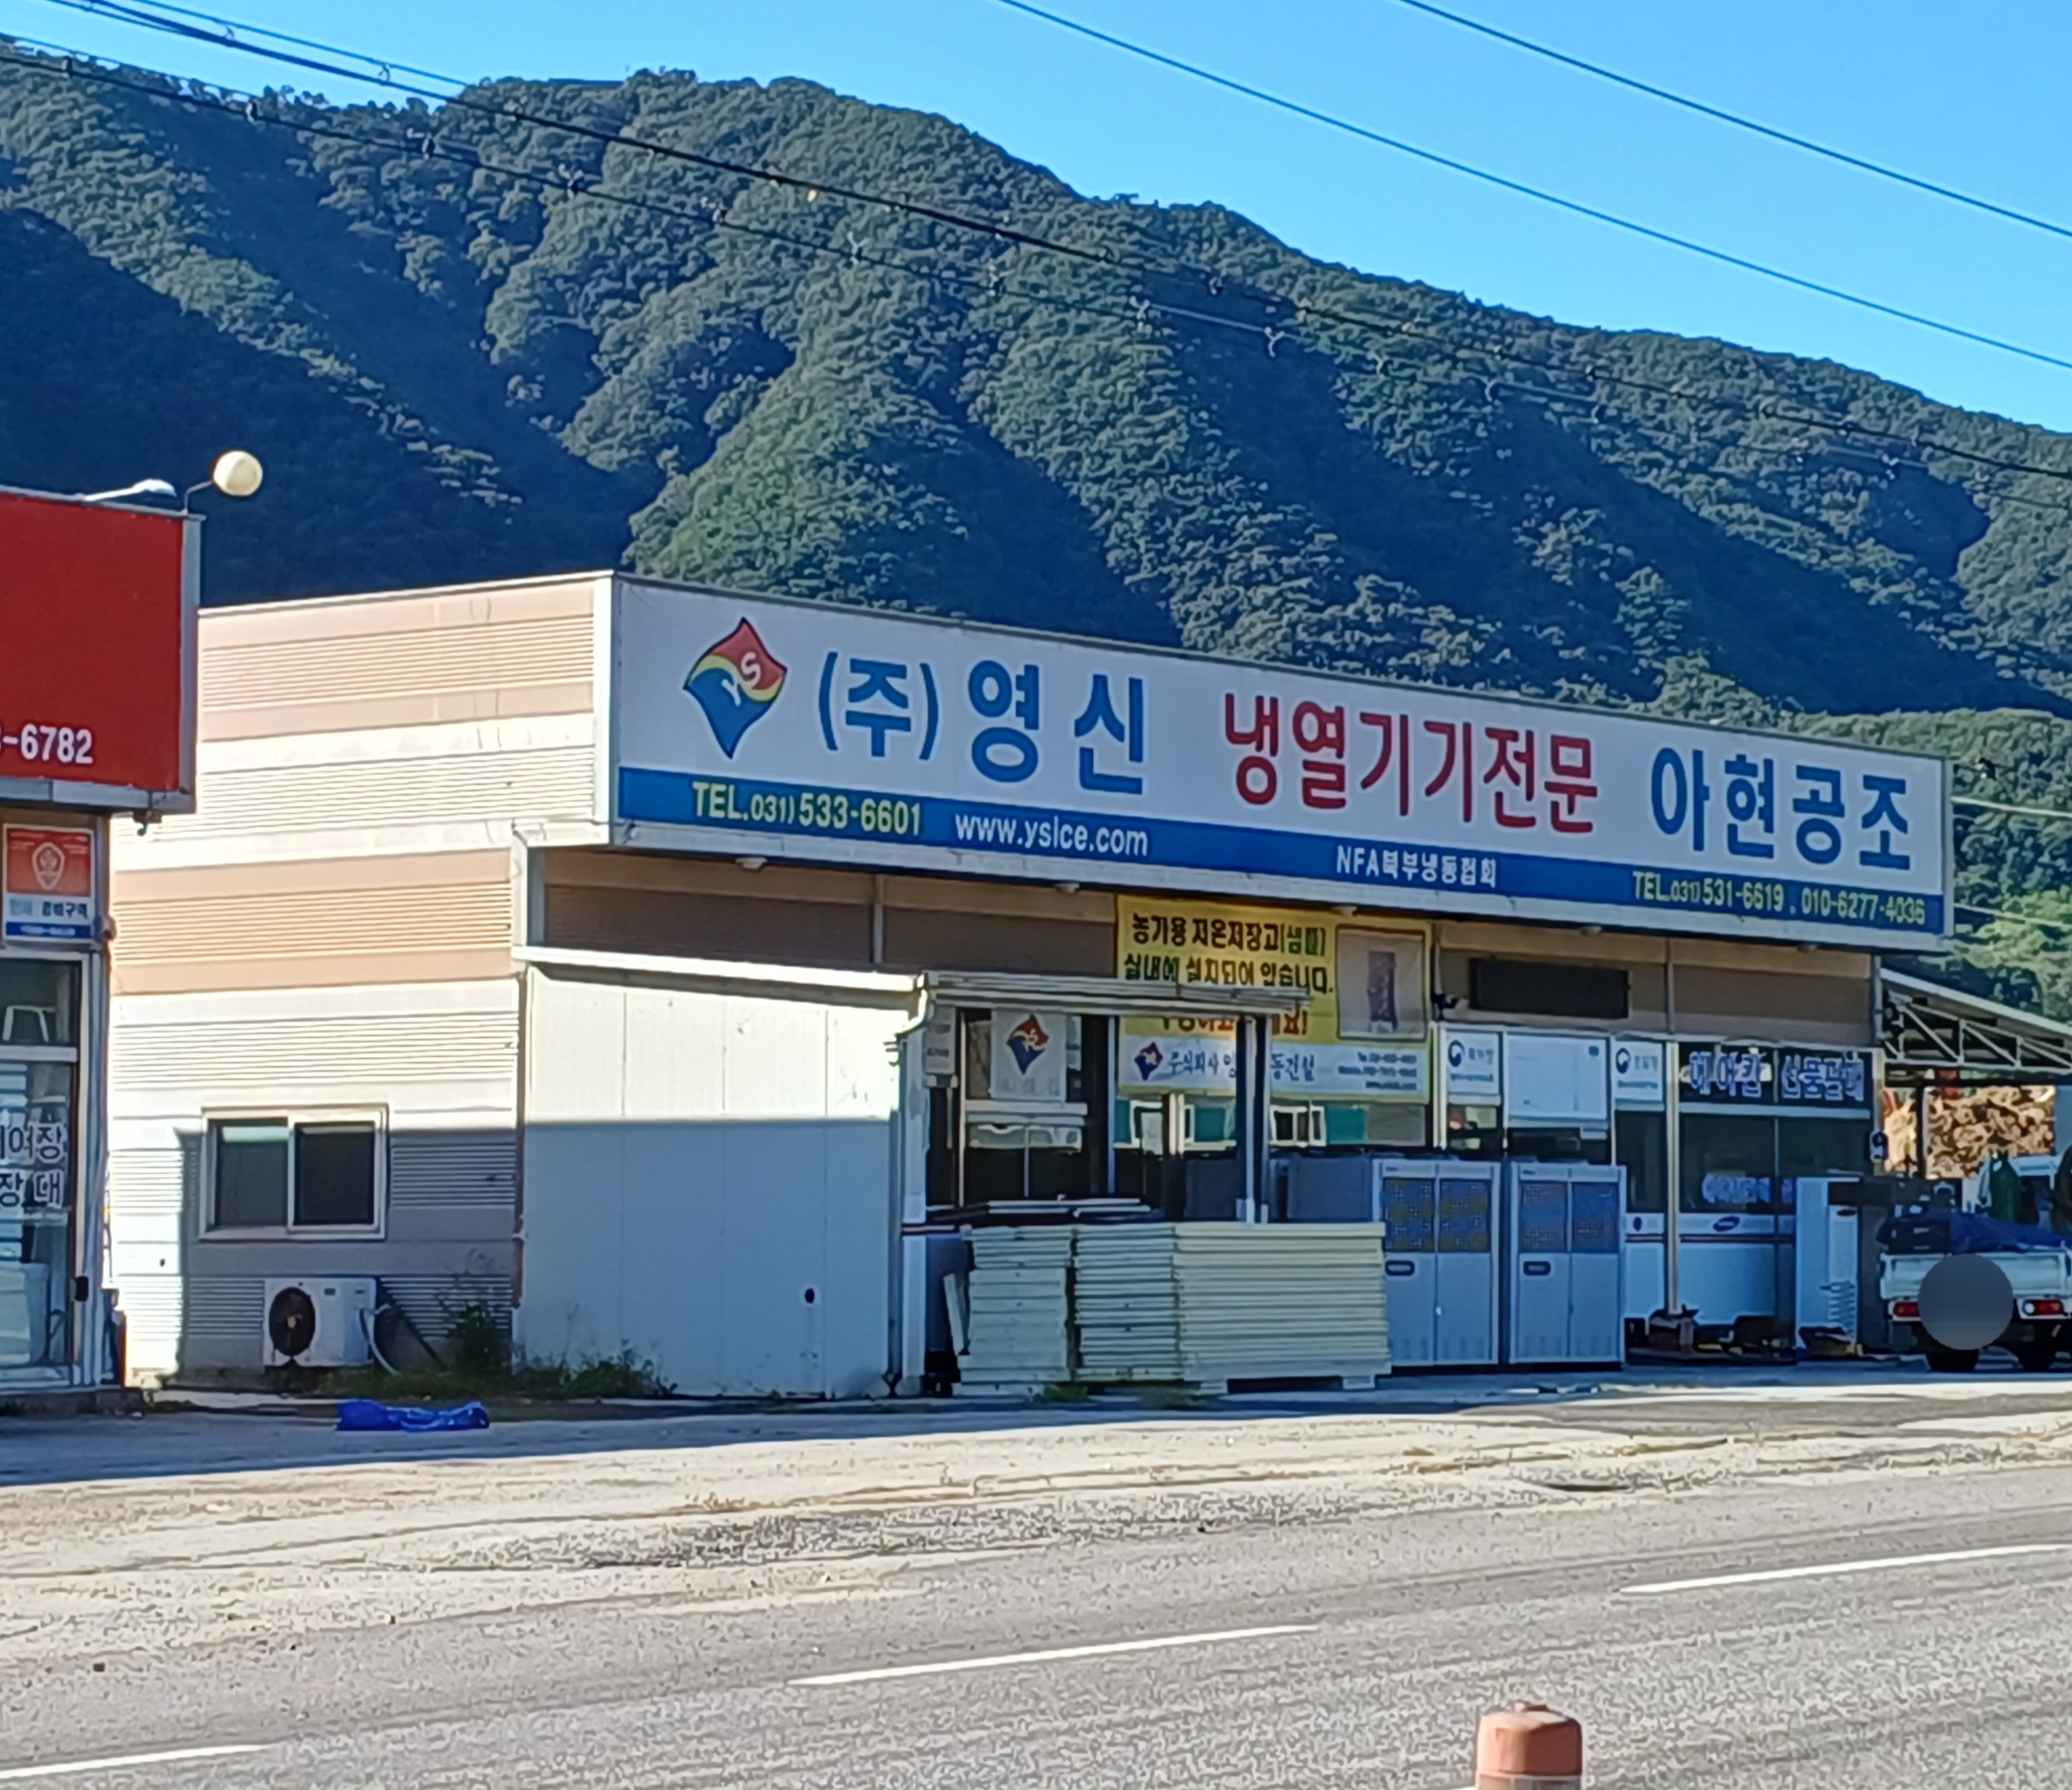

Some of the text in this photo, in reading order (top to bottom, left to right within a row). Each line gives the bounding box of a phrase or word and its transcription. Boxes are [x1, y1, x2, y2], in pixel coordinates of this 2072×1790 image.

[0, 723, 93, 764] -6782
[1225, 692, 1598, 834] 냉열기기전문
[1652, 747, 1910, 872] 아현공조
